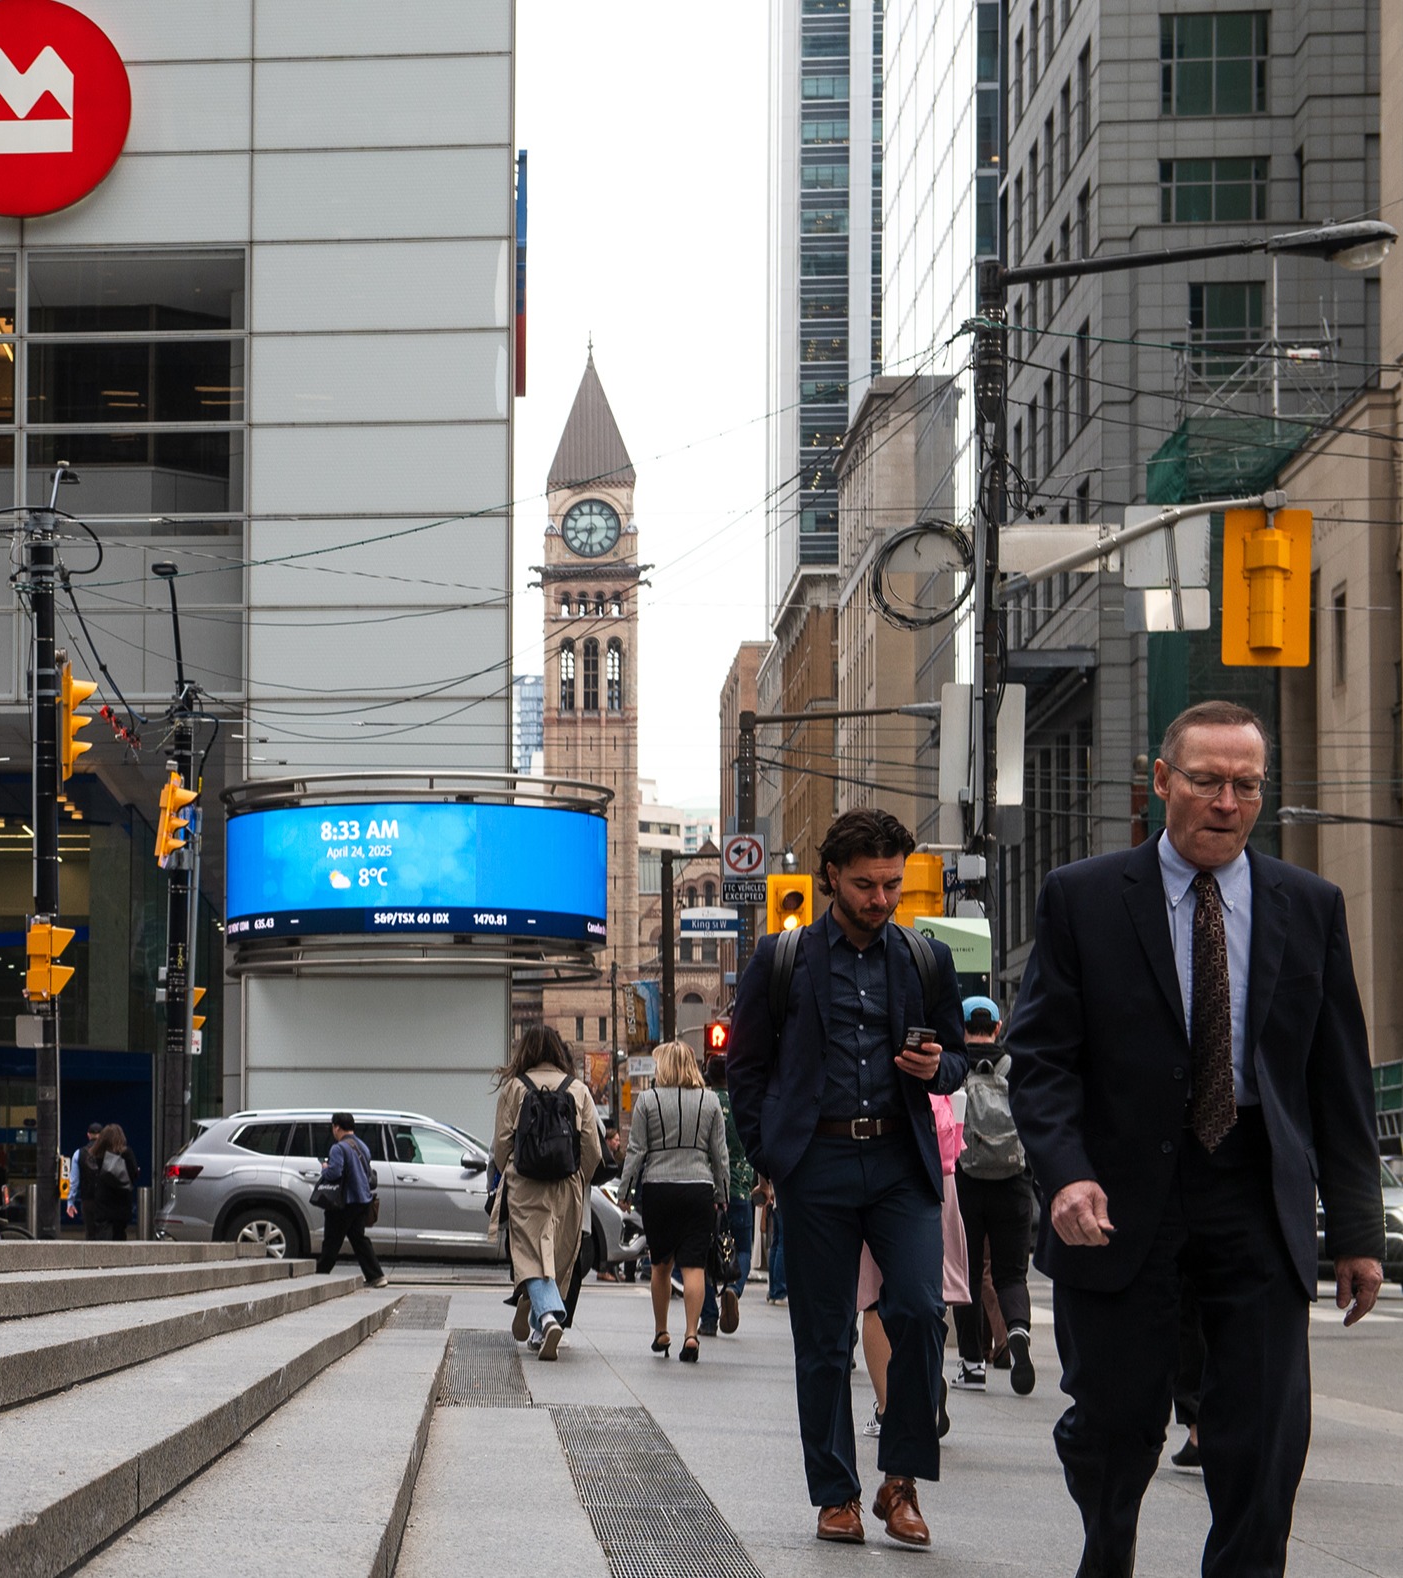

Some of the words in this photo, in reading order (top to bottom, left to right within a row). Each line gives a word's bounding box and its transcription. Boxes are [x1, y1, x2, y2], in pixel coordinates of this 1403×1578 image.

[320, 820, 360, 841] 8:33
[365, 819, 399, 839] AM
[326, 845, 348, 860] April
[351, 845, 365, 859] 24,
[368, 845, 392, 857] 2025
[358, 867, 388, 887] 8°C
[737, 883, 766, 891] VEHICLES
[725, 892, 764, 900] EXCEPTED
[254, 917, 275, 930] 635.43
[374, 912, 415, 926] S&P/TSX
[417, 913, 431, 924] 60
[432, 912, 450, 924] IDX
[473, 913, 508, 926] 1470.81
[691, 920, 711, 930] King
[719, 920, 727, 929] W
[624, 985, 637, 1035] DISCOVER
